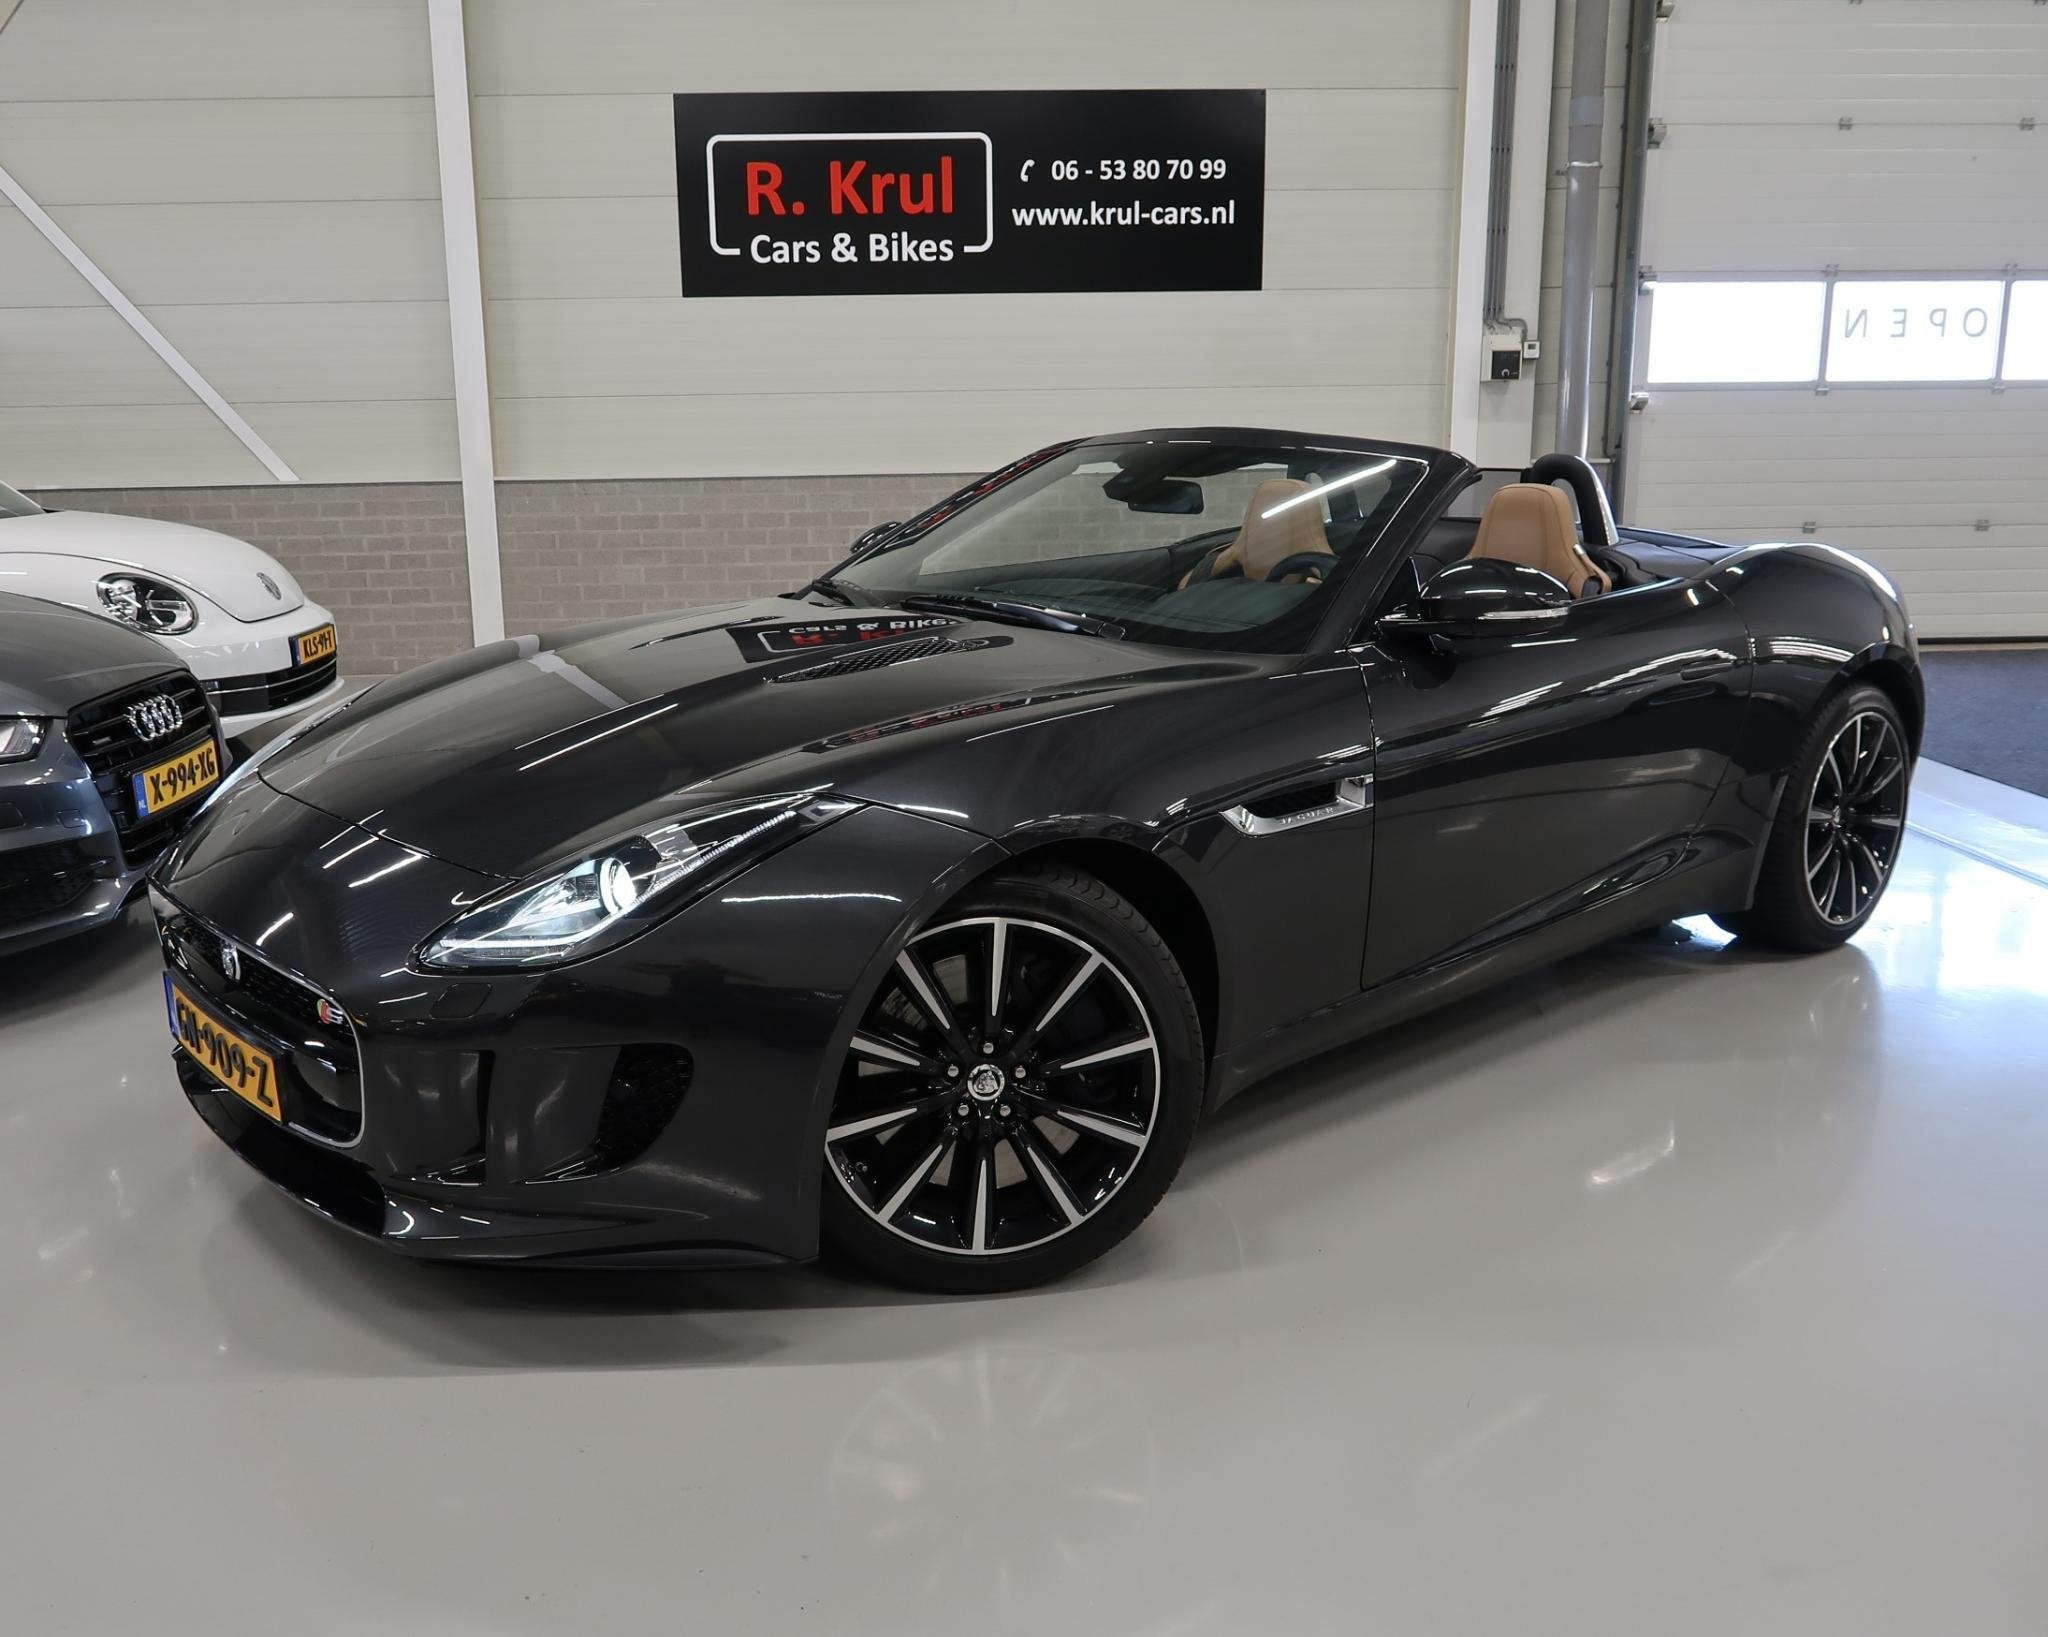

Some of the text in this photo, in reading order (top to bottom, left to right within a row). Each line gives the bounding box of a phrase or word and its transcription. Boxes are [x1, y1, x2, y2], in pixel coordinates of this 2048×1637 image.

[746, 155, 954, 215] R. Krul
[1051, 159, 1079, 181] 06
[1099, 159, 1126, 180] 53
[1132, 159, 1160, 180] 80
[1166, 158, 1194, 180] 70
[1199, 158, 1227, 180] 99
[1011, 199, 1235, 226] www.krul-cars.nl
[750, 231, 954, 264] Cars & Bikes
[149, 747, 216, 806] X-994-XG
